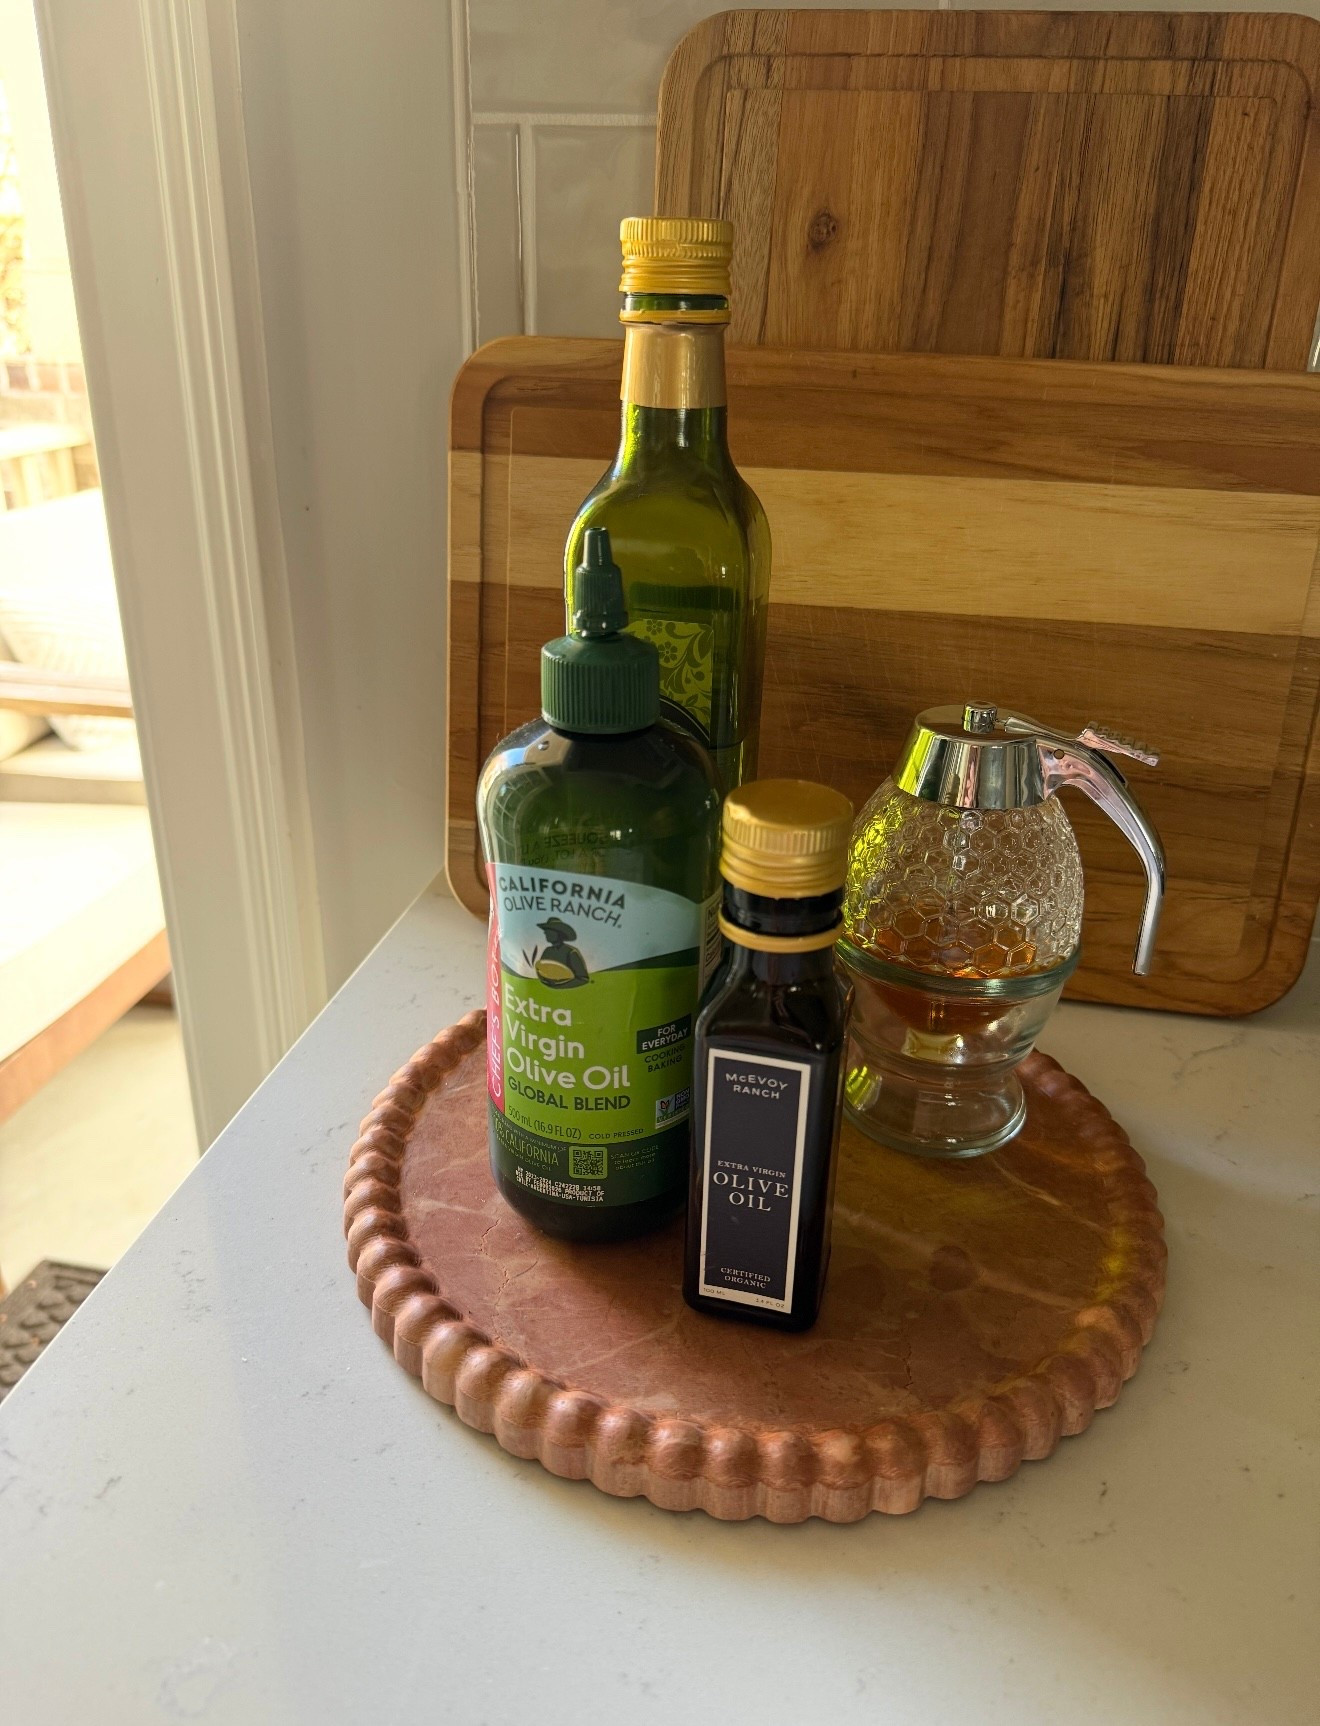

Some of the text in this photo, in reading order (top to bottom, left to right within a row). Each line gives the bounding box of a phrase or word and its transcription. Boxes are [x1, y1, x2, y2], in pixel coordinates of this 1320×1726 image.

[499, 876, 626, 910] CALIFORNIA
[504, 896, 622, 928] OLIVE RANCH
[504, 982, 572, 1027] Extra
[506, 1015, 585, 1061] Virgin
[642, 1027, 688, 1051] EVERYDAY
[657, 1024, 676, 1037] FOR
[491, 1011, 502, 1098] CHEF'S
[644, 1043, 686, 1063] COOKING
[648, 1054, 682, 1073] BAKING
[506, 1046, 631, 1090] Olive Oil
[508, 1075, 631, 1111] GLOBAL BLEND
[725, 1072, 788, 1091] McEVOY
[733, 1084, 780, 1099] RANCH
[508, 1106, 521, 1122] 500
[522, 1115, 533, 1128] mL
[534, 1119, 553, 1134] (16.9
[555, 1126, 564, 1137] FL
[566, 1129, 582, 1141] OZ)
[588, 1128, 644, 1140] COLD PRESSED
[505, 1129, 559, 1166] CALIFORNIA
[717, 1160, 786, 1179] EXTRA VIRGIN
[713, 1171, 789, 1198] OLIVE
[728, 1191, 771, 1212] OIL
[720, 1267, 771, 1282] CERTIFIED
[724, 1275, 767, 1289] ORGANIC
